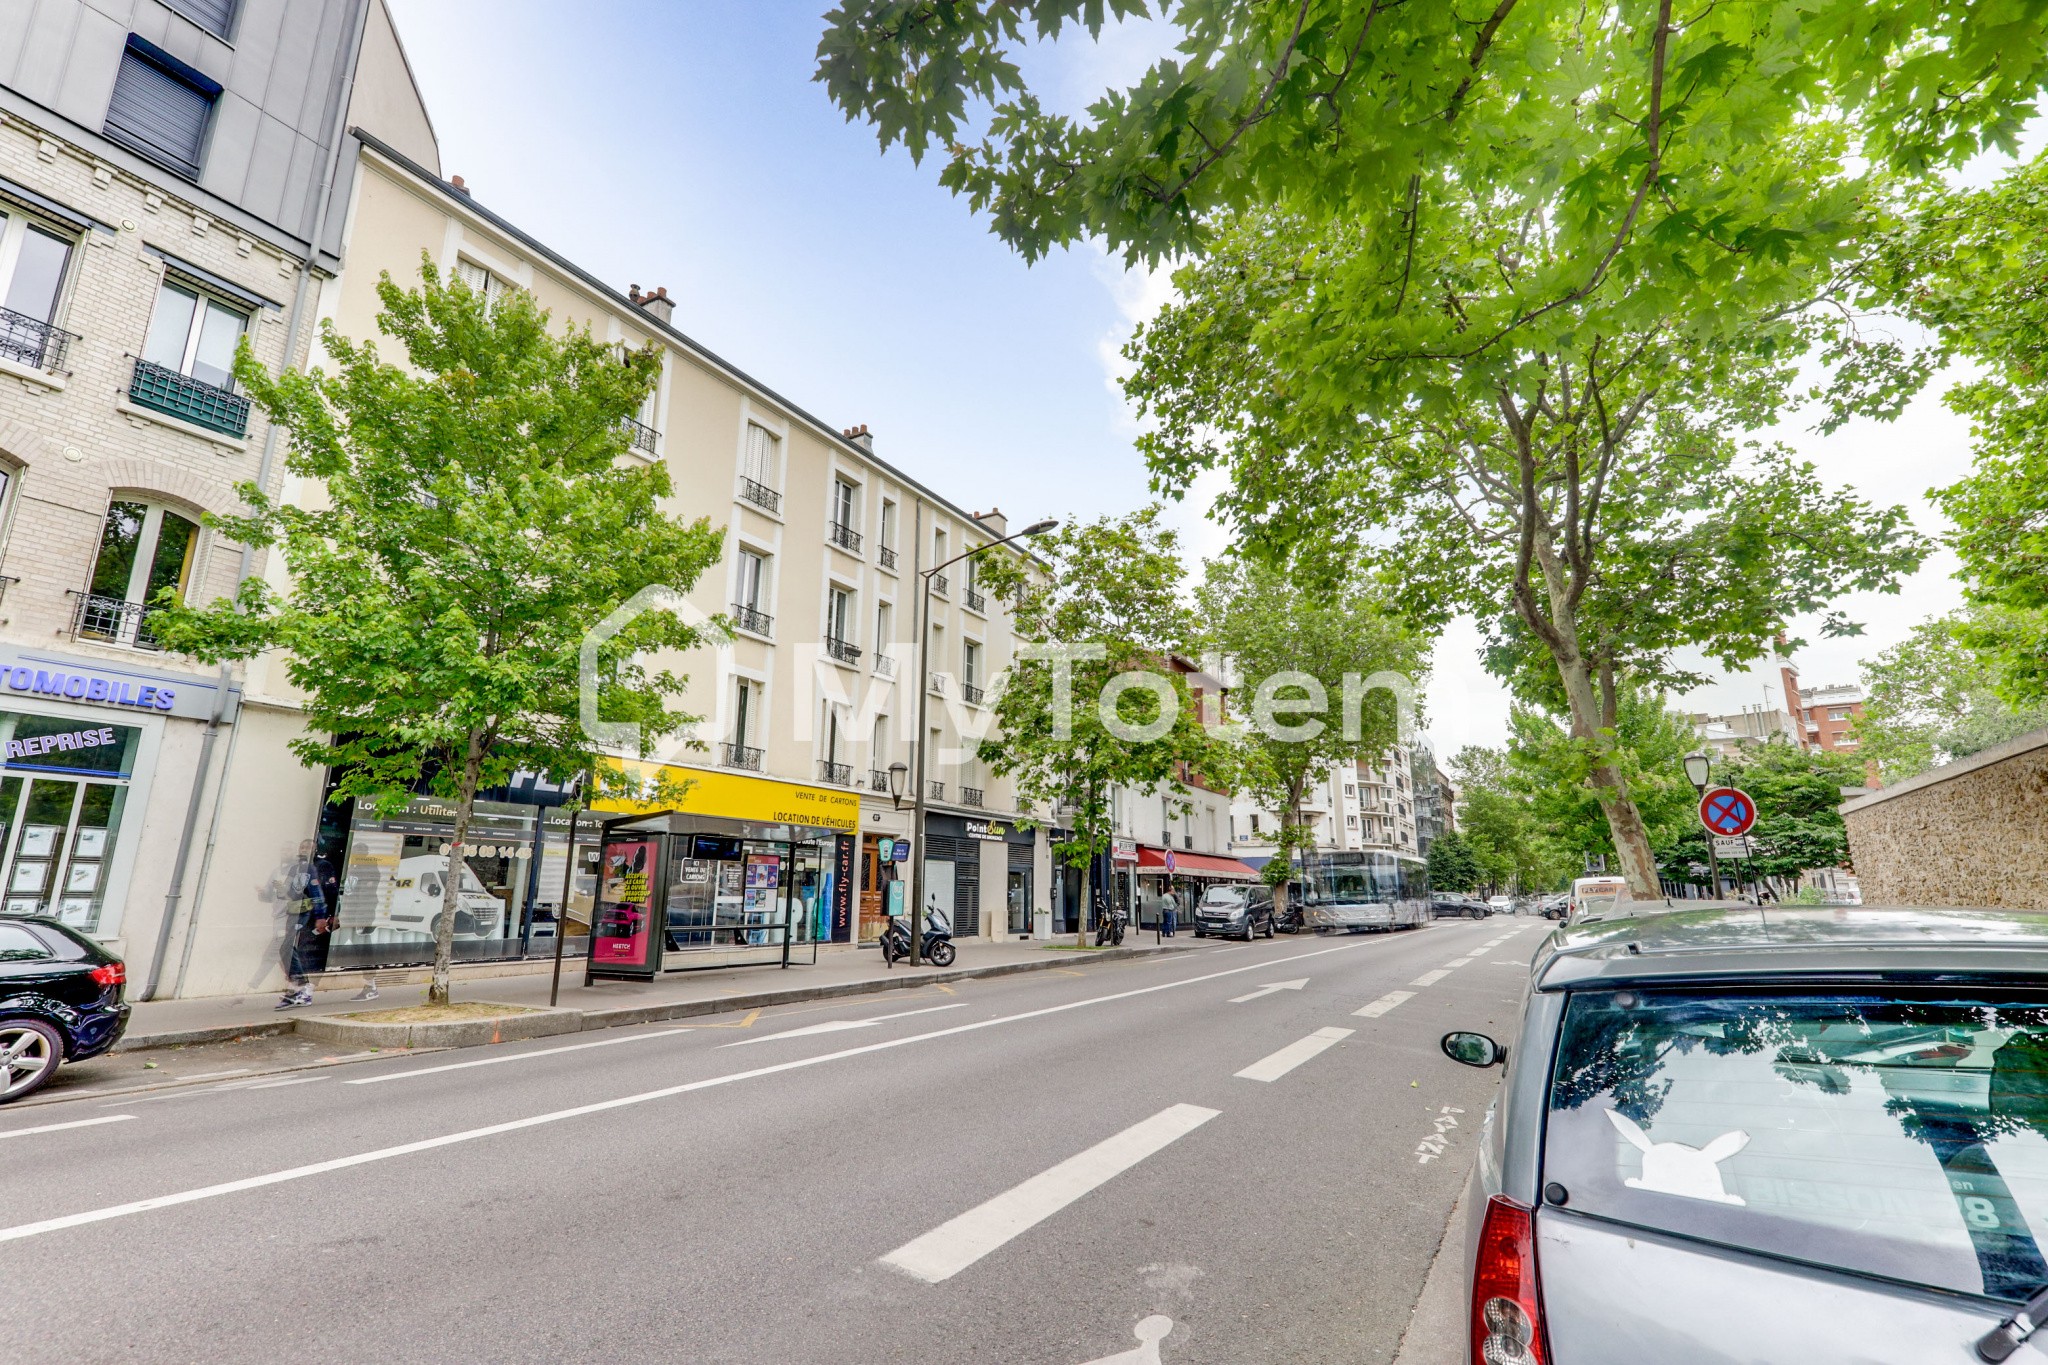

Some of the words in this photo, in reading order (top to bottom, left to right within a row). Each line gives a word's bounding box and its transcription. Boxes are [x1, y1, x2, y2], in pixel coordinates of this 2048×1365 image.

[5, 727, 116, 758] REPRISE
[795, 791, 815, 801] VENTE
[819, 794, 827, 802] DE
[830, 796, 857, 806] CARTONS
[773, 811, 809, 823] LOCATION
[811, 816, 820, 825] DE
[821, 815, 856, 829] VÉHICULES
[966, 821, 987, 833] Point
[987, 819, 1005, 835] Sun
[839, 841, 849, 927] www.fly-car.fr
[1955, 1196, 2000, 1228] 8
